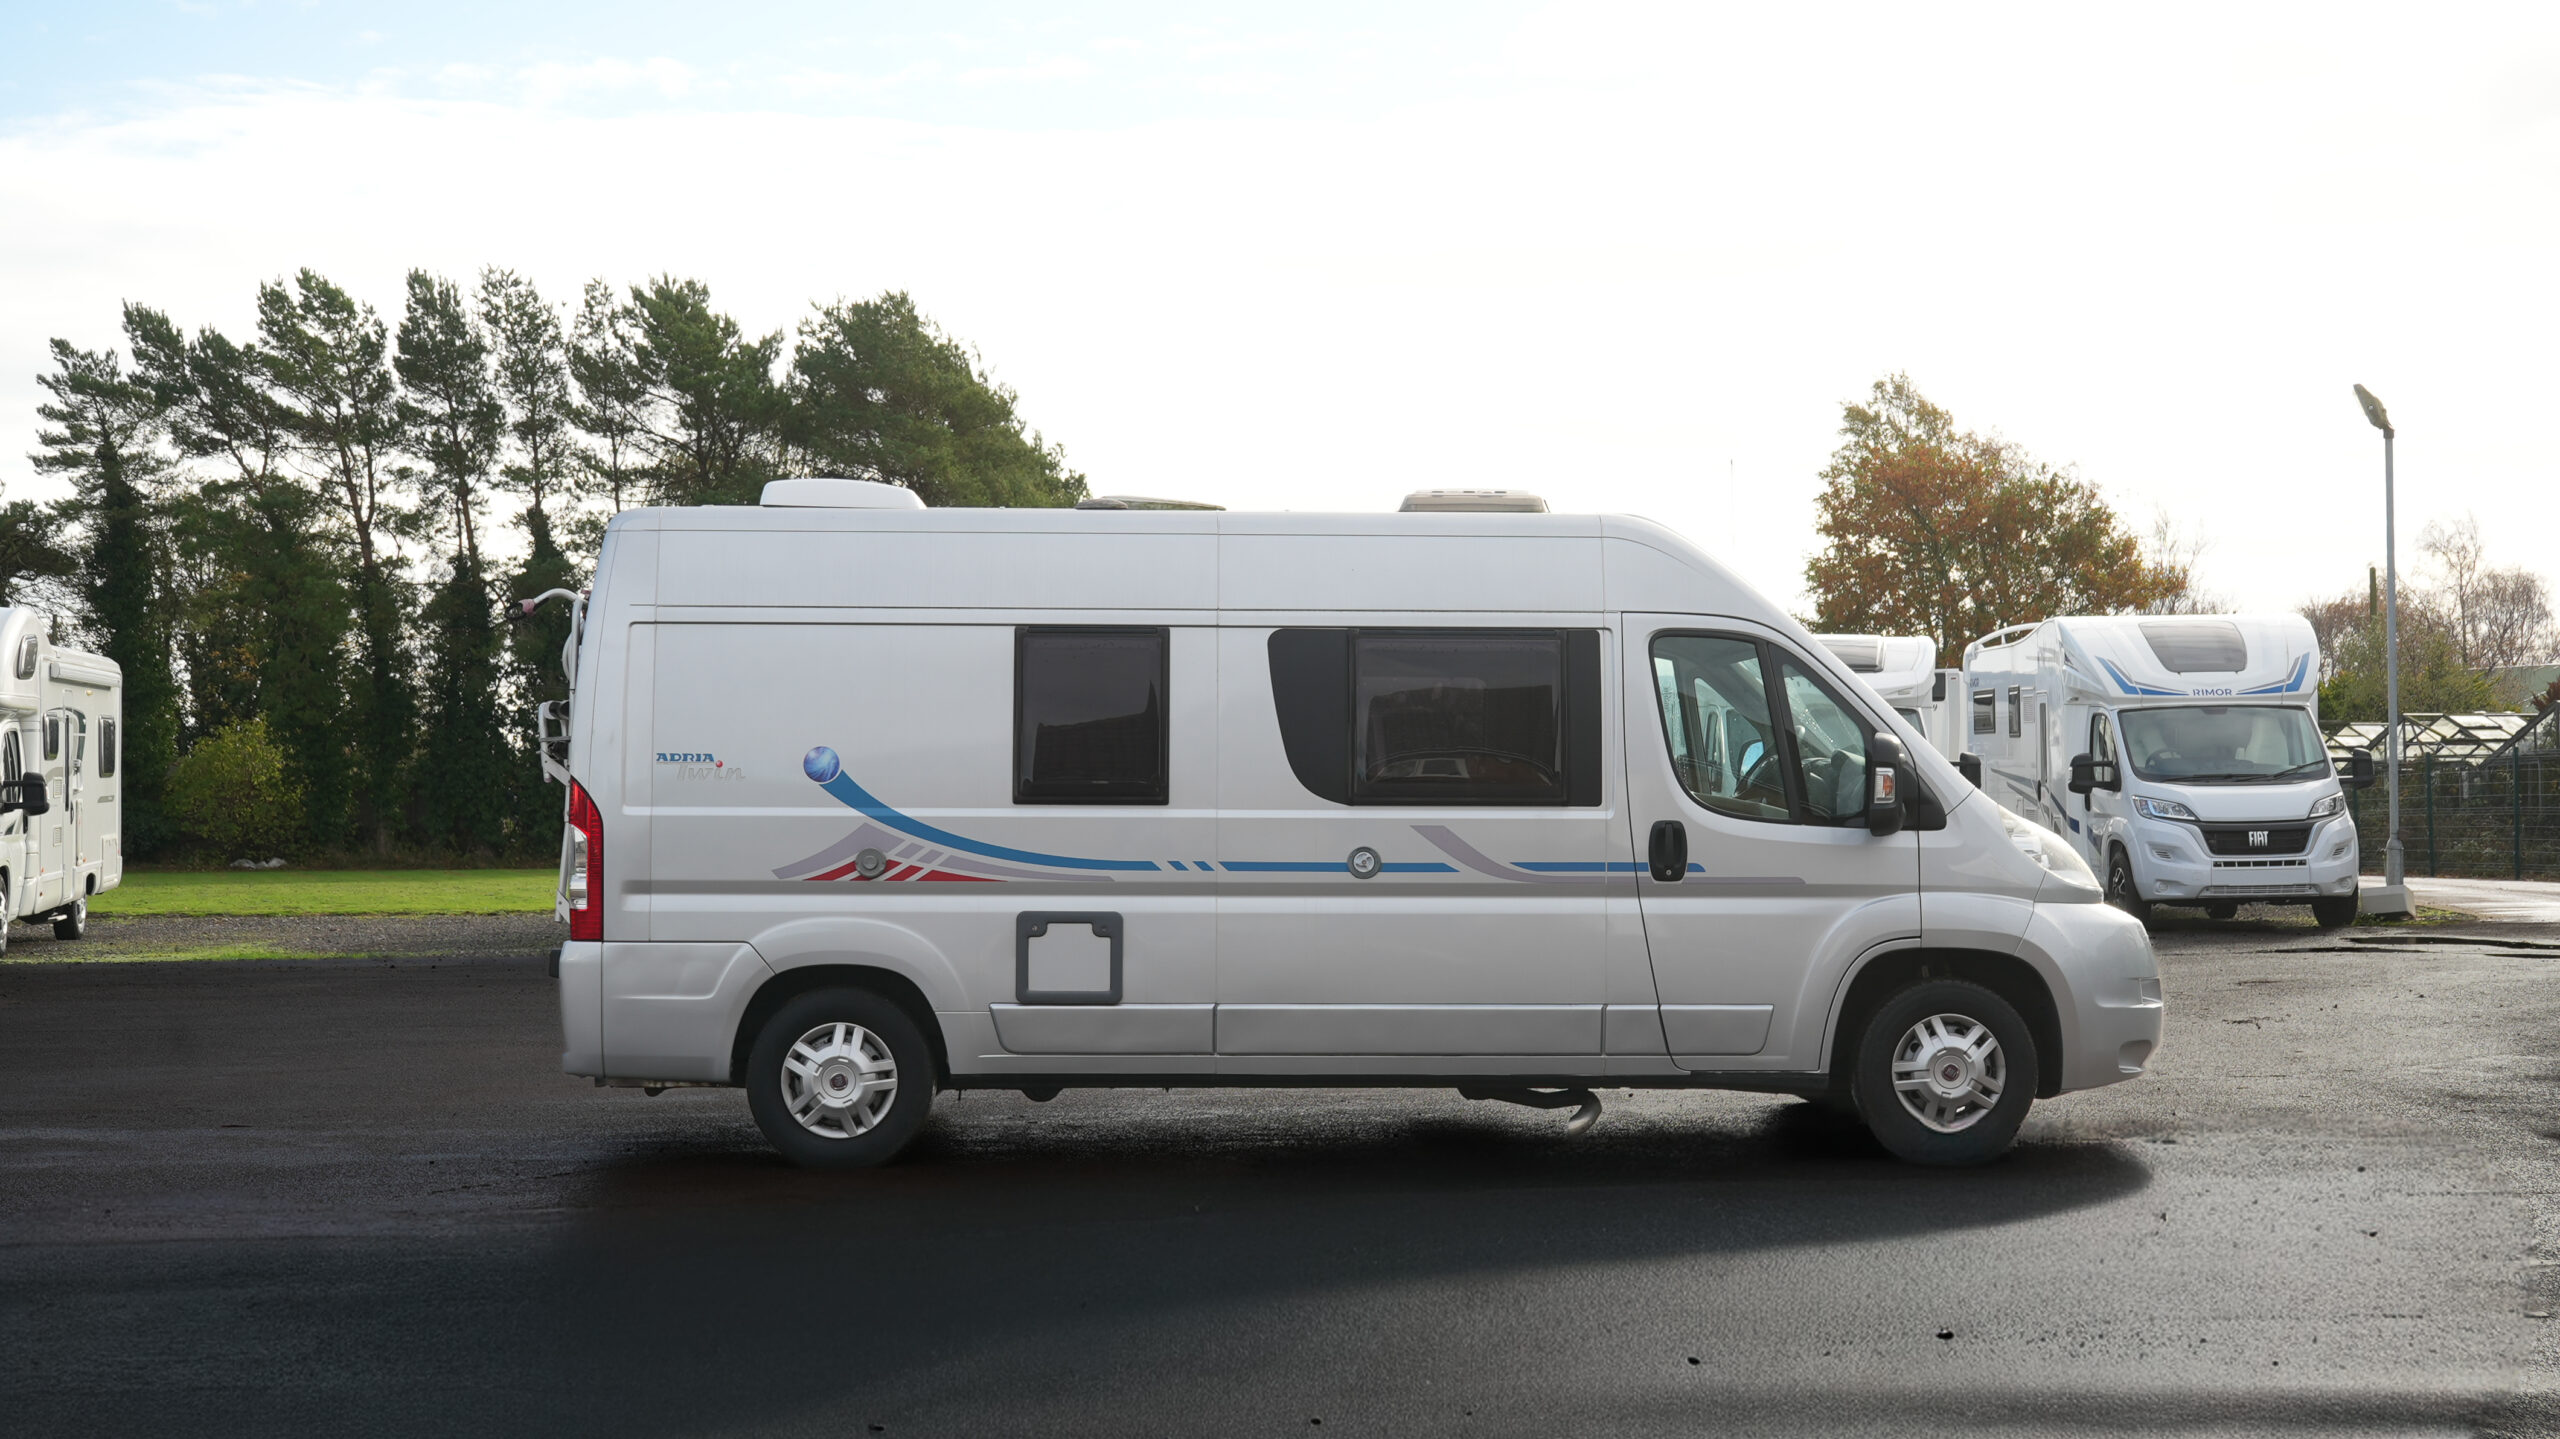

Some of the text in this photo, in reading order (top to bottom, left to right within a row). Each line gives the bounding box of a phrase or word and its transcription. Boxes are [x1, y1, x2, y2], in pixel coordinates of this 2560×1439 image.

[2192, 688, 2233, 697] RIMOR
[656, 752, 715, 762] ADRIA
[2248, 830, 2270, 847] FIAT
